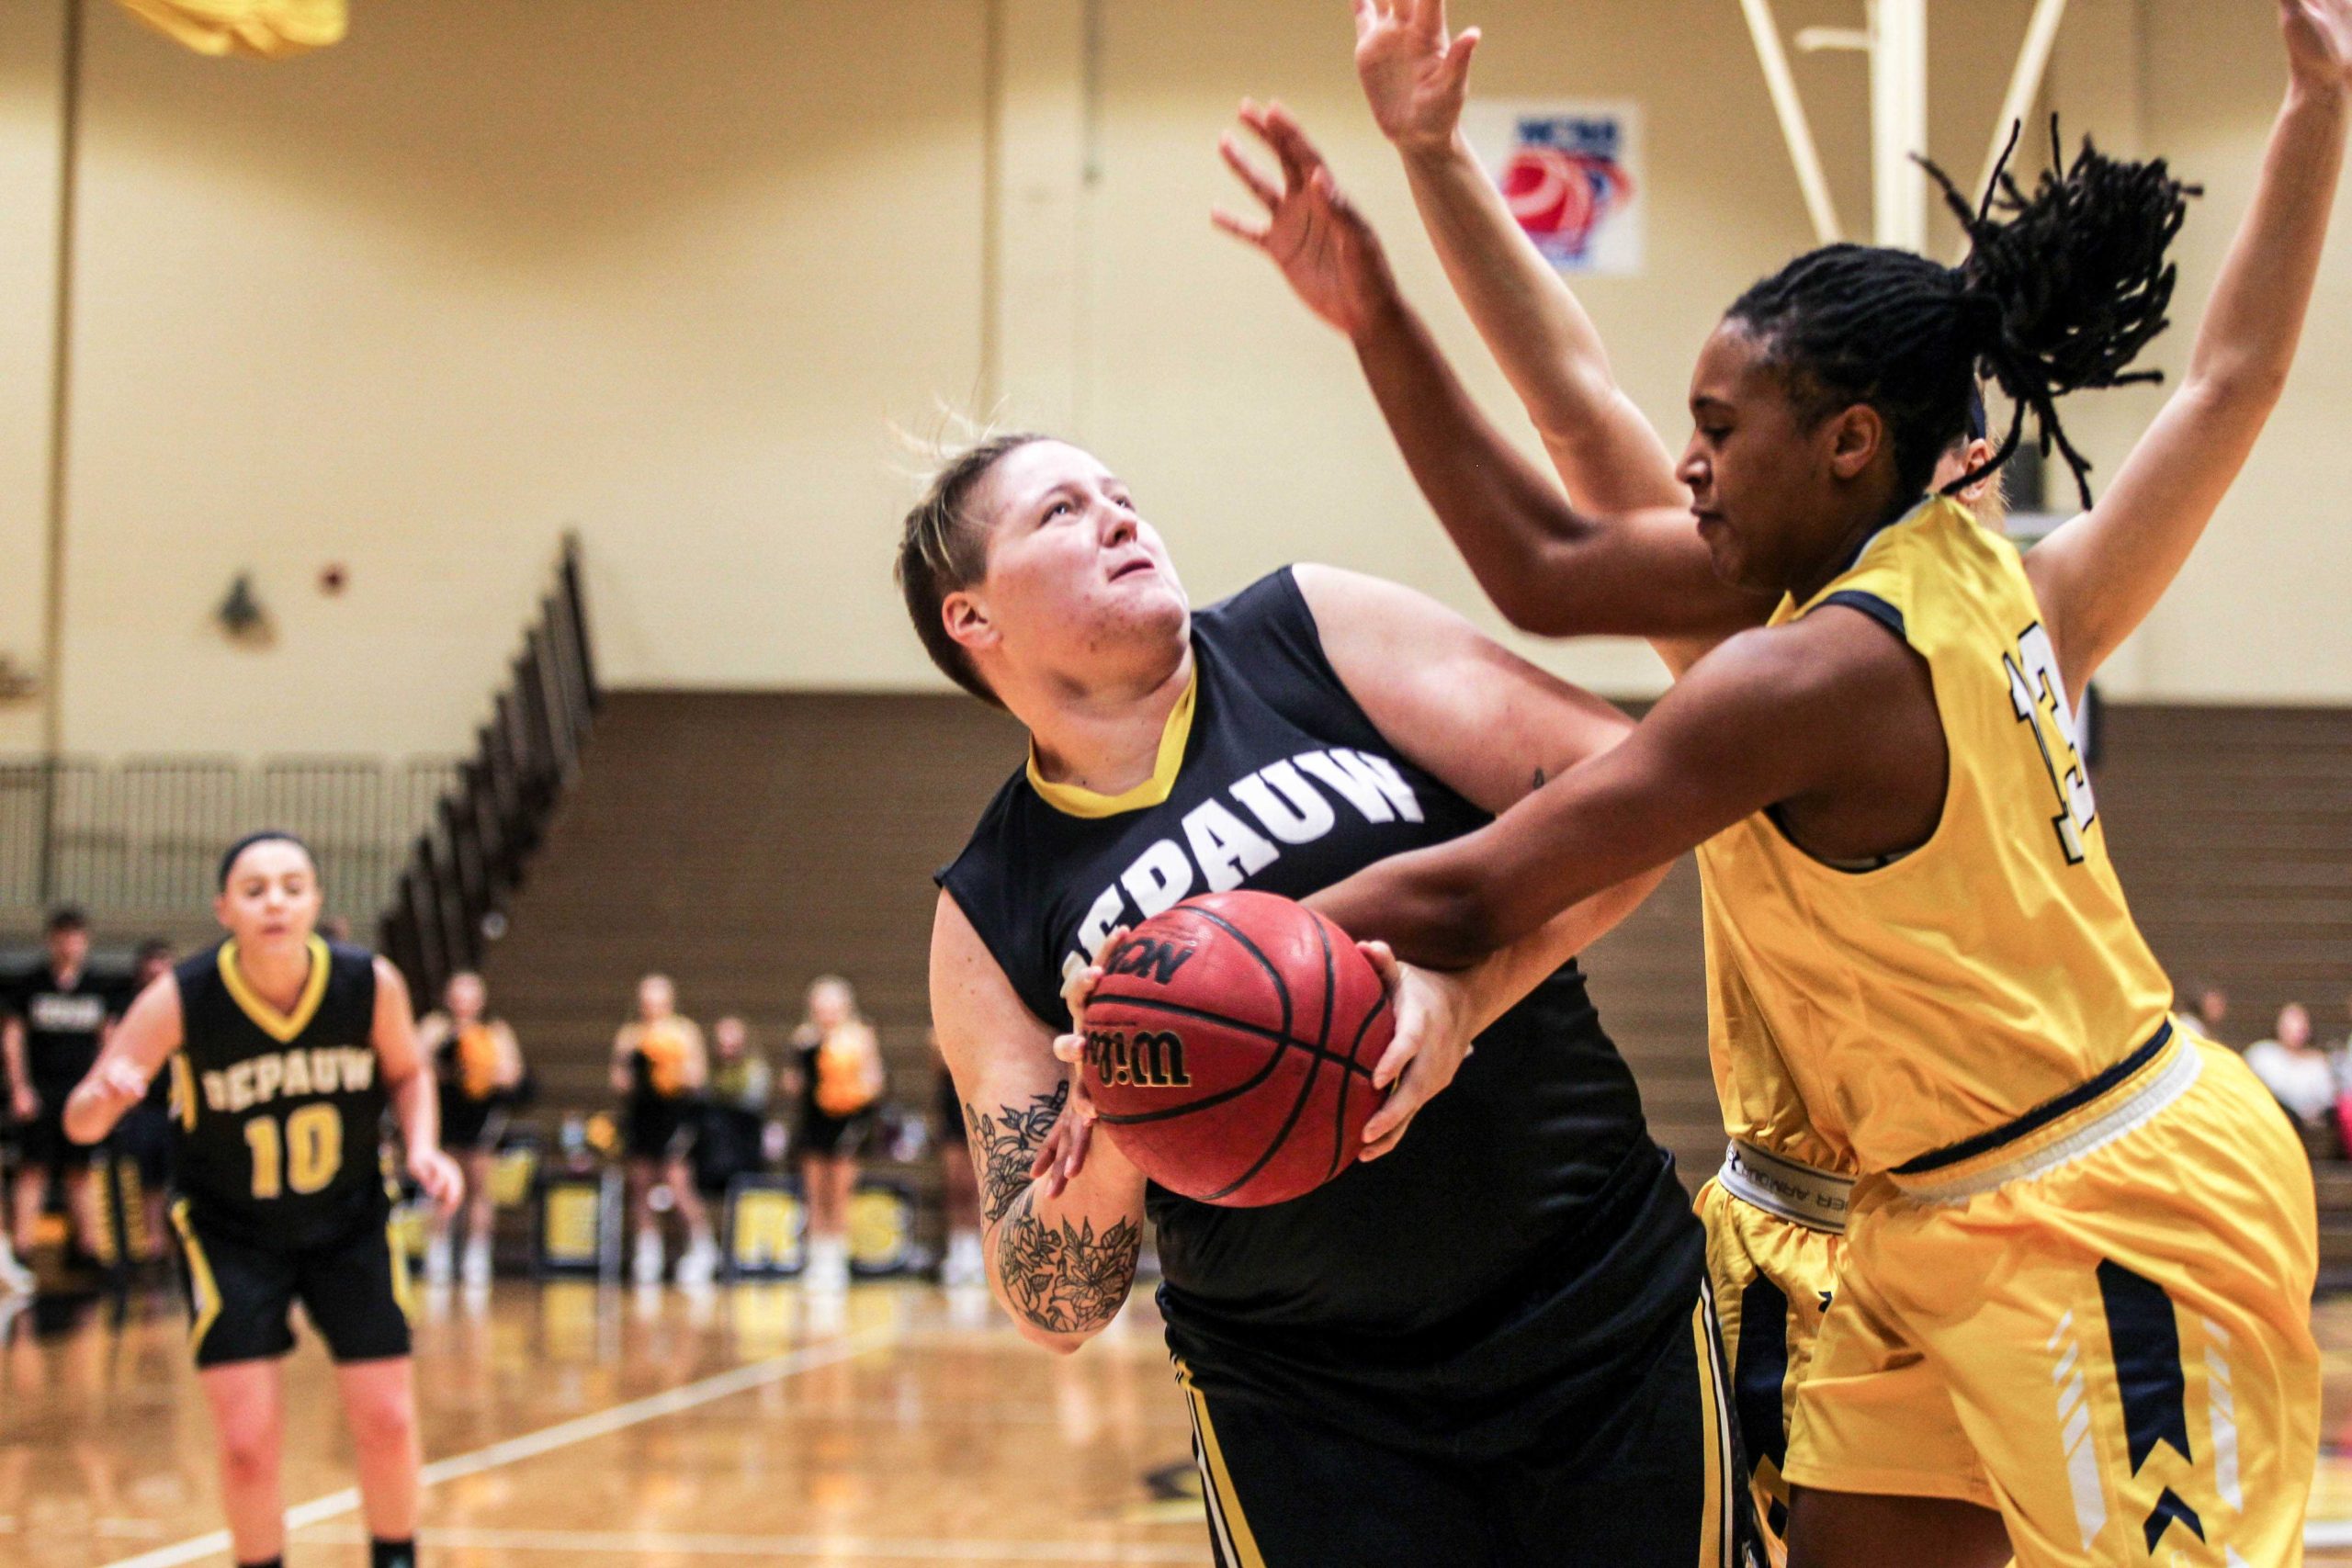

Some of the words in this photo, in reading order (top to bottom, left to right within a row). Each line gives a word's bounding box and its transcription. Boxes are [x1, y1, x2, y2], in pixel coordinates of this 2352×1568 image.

[2002, 619, 2096, 864] 13
[201, 1045, 375, 1112] DEPAUW
[244, 1103, 344, 1199] 10
[1817, 1191, 1849, 1213] ER
